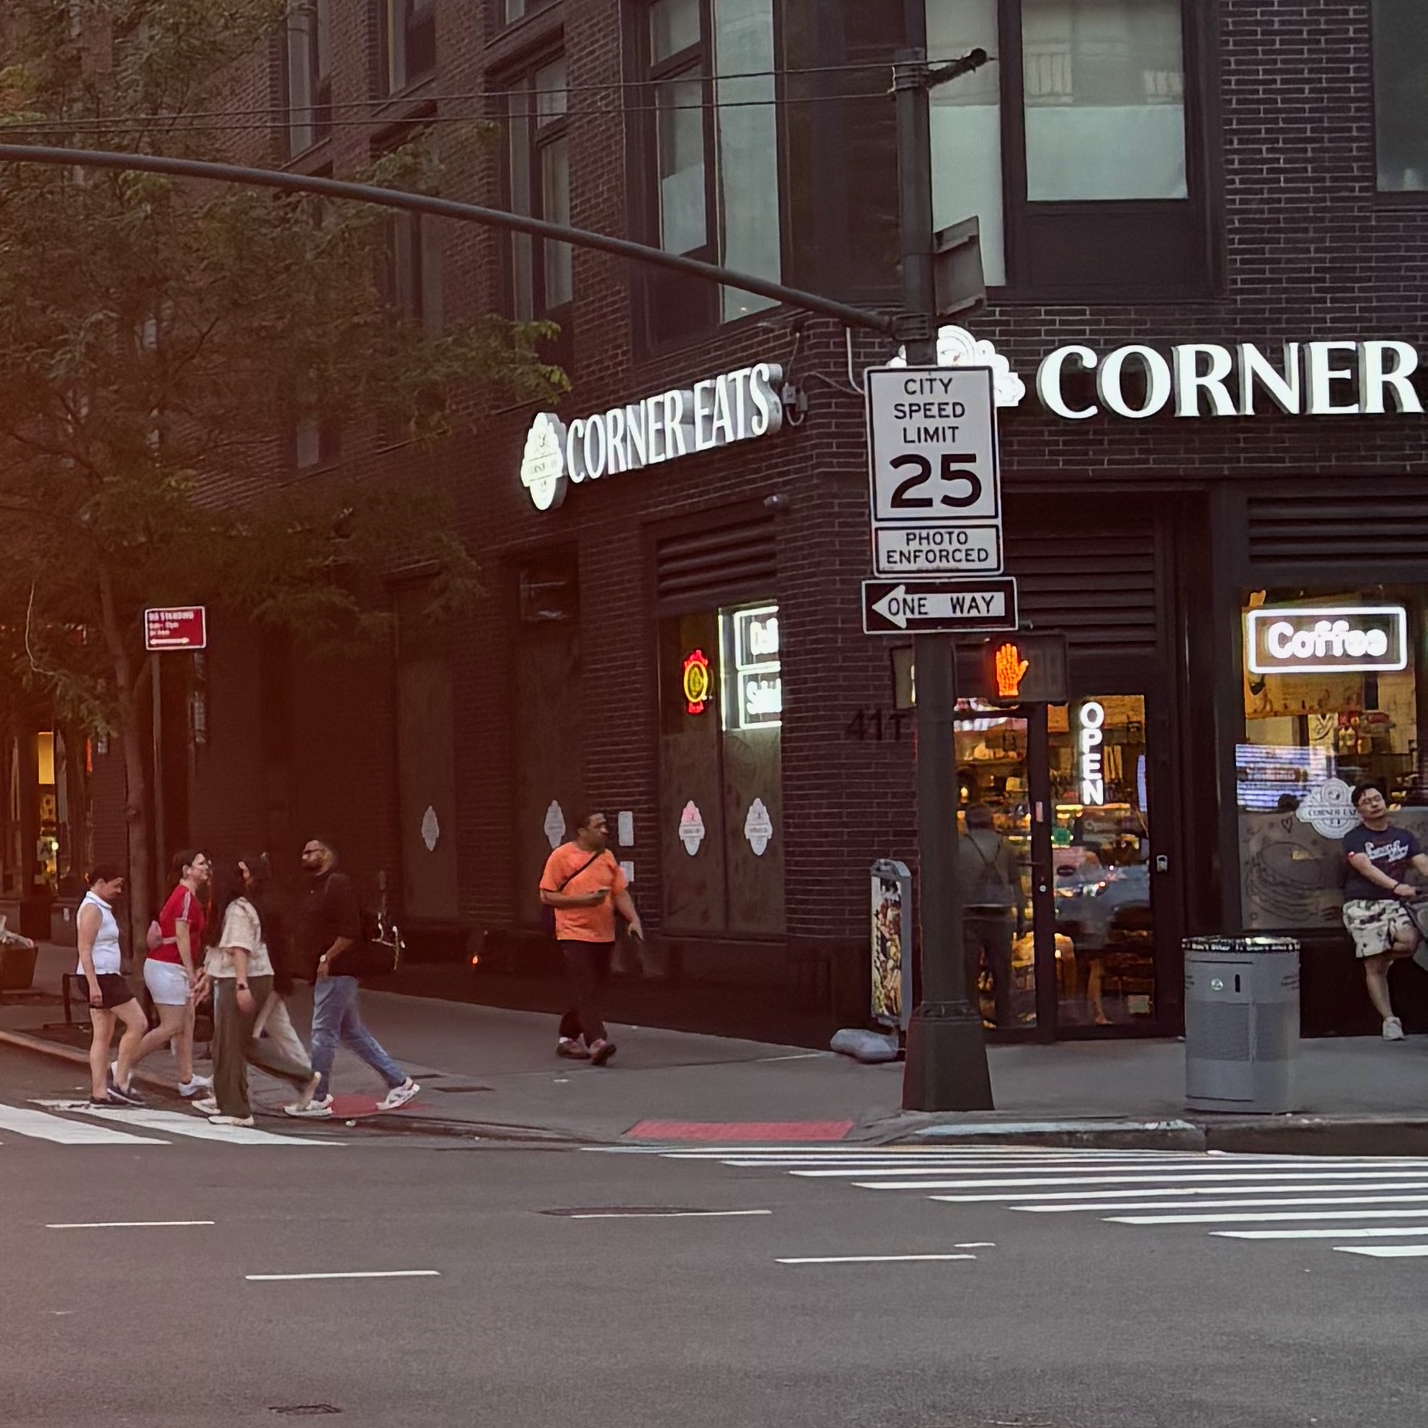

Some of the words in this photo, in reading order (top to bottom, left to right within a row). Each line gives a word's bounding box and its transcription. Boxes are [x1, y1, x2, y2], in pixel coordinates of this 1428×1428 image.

[904, 377, 953, 395] CITY
[1037, 340, 1425, 419] CORNER
[893, 402, 966, 420] SPEED
[567, 389, 692, 484] CORNER
[694, 362, 782, 452] EATS
[903, 426, 959, 444] LIMIT
[889, 453, 982, 509] 25
[905, 530, 969, 546] PHOTO
[886, 548, 989, 565] ENFORCED
[887, 597, 929, 616] ONE
[950, 595, 995, 615] WAY
[1268, 619, 1388, 659] Coffee
[1080, 701, 1104, 805] OPEN
